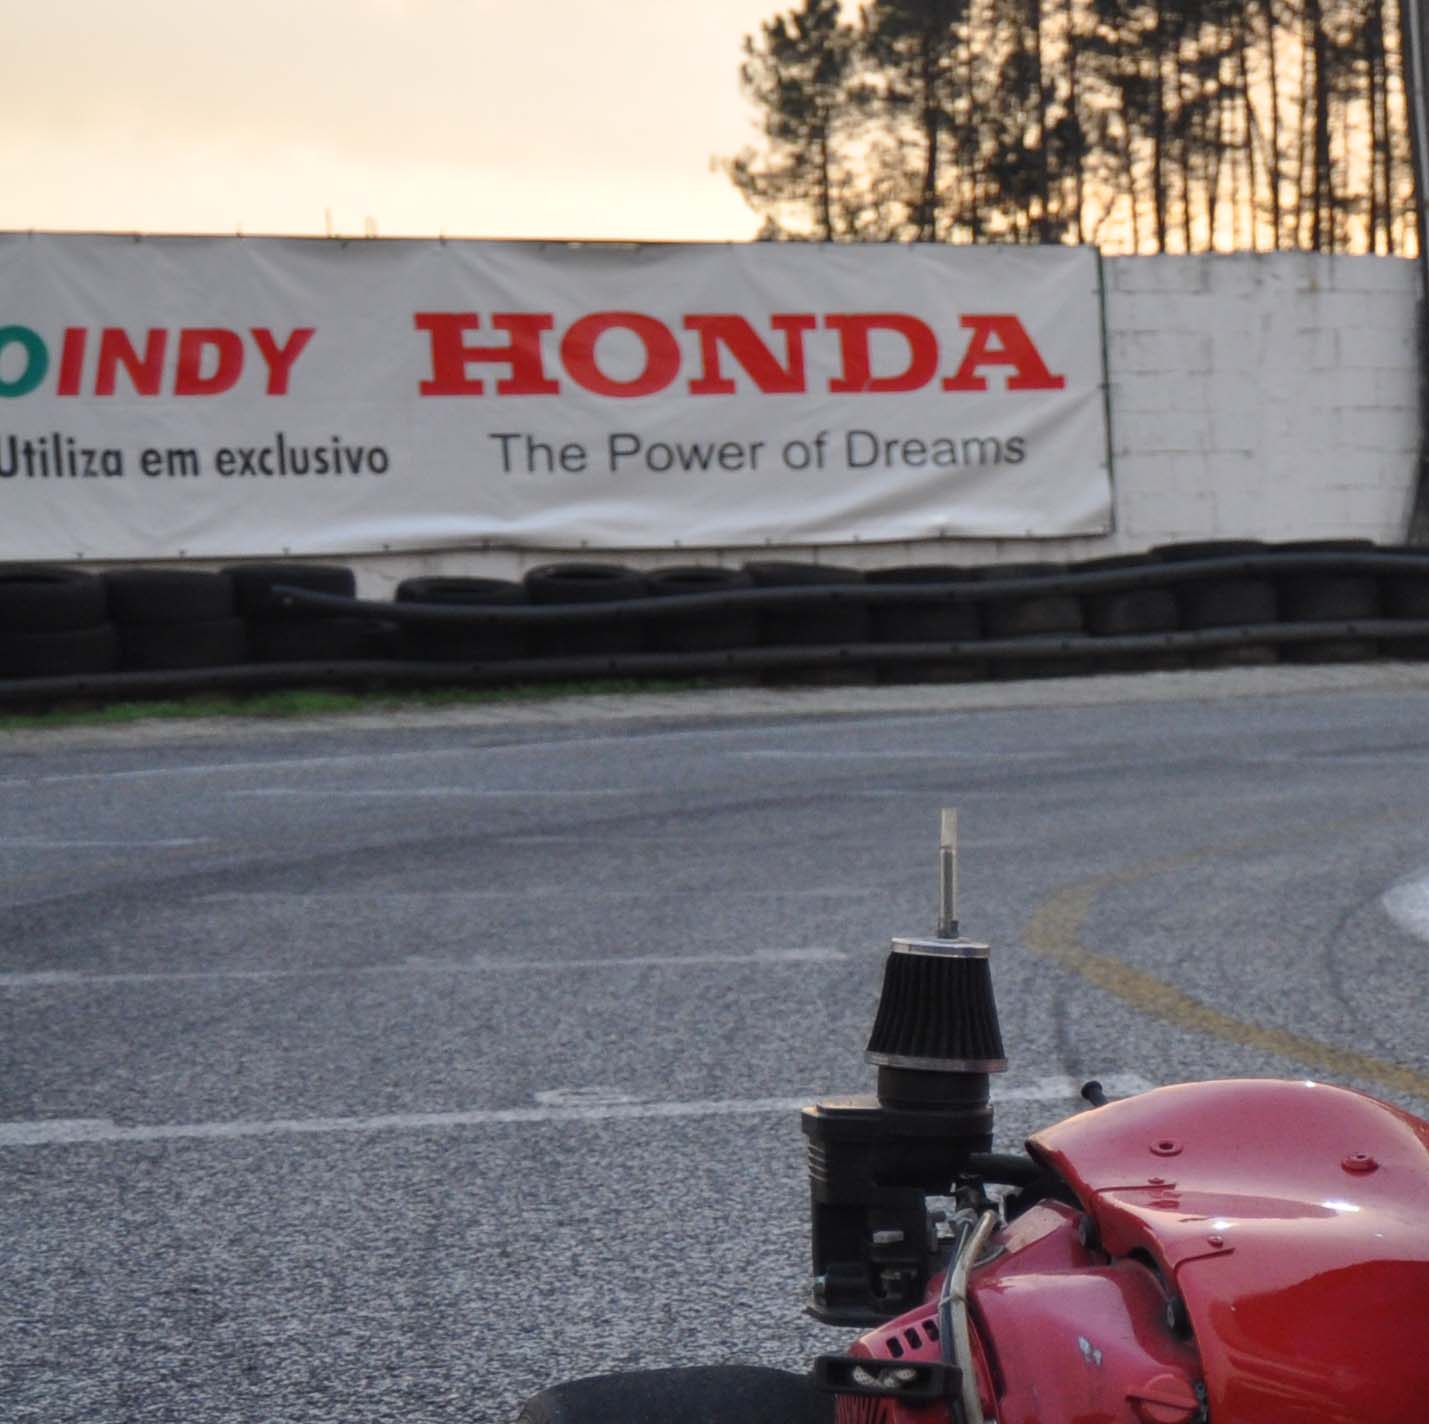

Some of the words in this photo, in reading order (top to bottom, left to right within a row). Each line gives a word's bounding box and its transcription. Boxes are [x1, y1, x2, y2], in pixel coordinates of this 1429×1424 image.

[414, 312, 1065, 398] HONDA
[0, 432, 124, 479] Utiliza
[140, 448, 200, 478] em
[215, 431, 390, 477] exclusivo
[489, 432, 588, 474] The
[607, 432, 766, 474] Power
[782, 430, 828, 472] of
[844, 428, 1027, 470] Dreams
